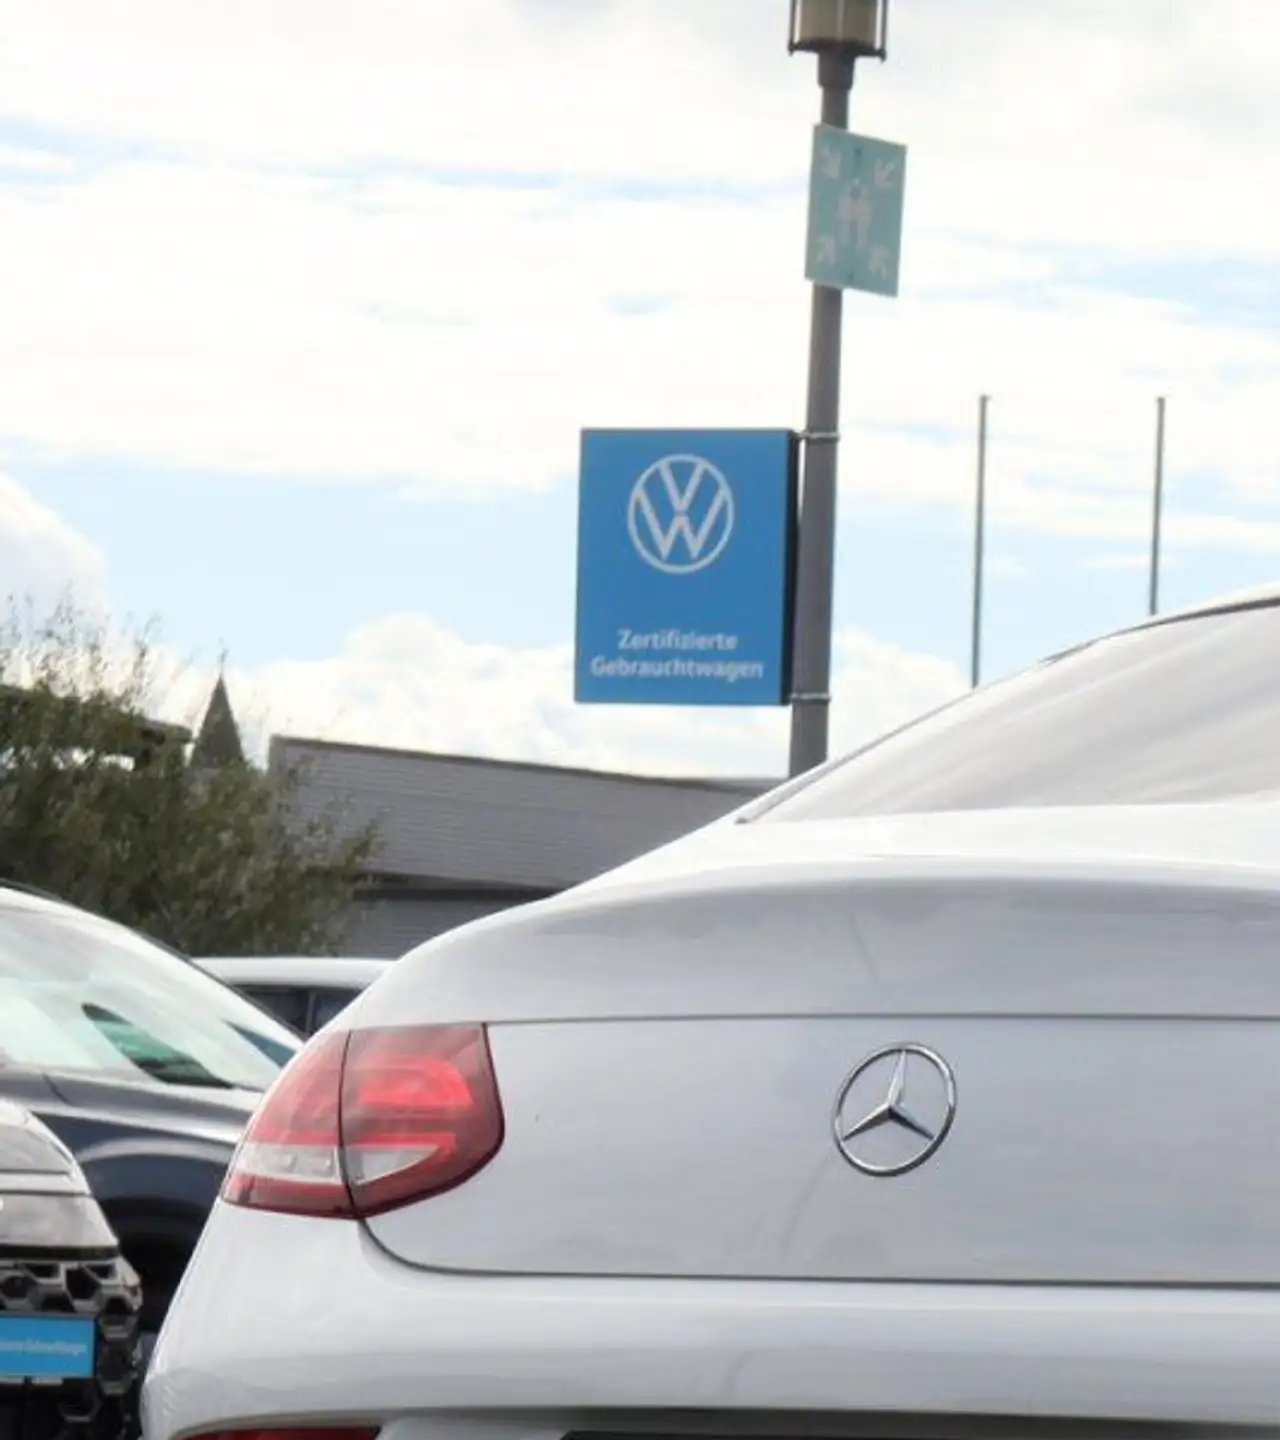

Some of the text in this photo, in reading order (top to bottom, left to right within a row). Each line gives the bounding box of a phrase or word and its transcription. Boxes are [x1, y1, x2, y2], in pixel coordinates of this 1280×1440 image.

[629, 454, 733, 573] VW
[618, 629, 738, 650] Zertifizierte
[591, 655, 764, 682] Gebrauchtwagen
